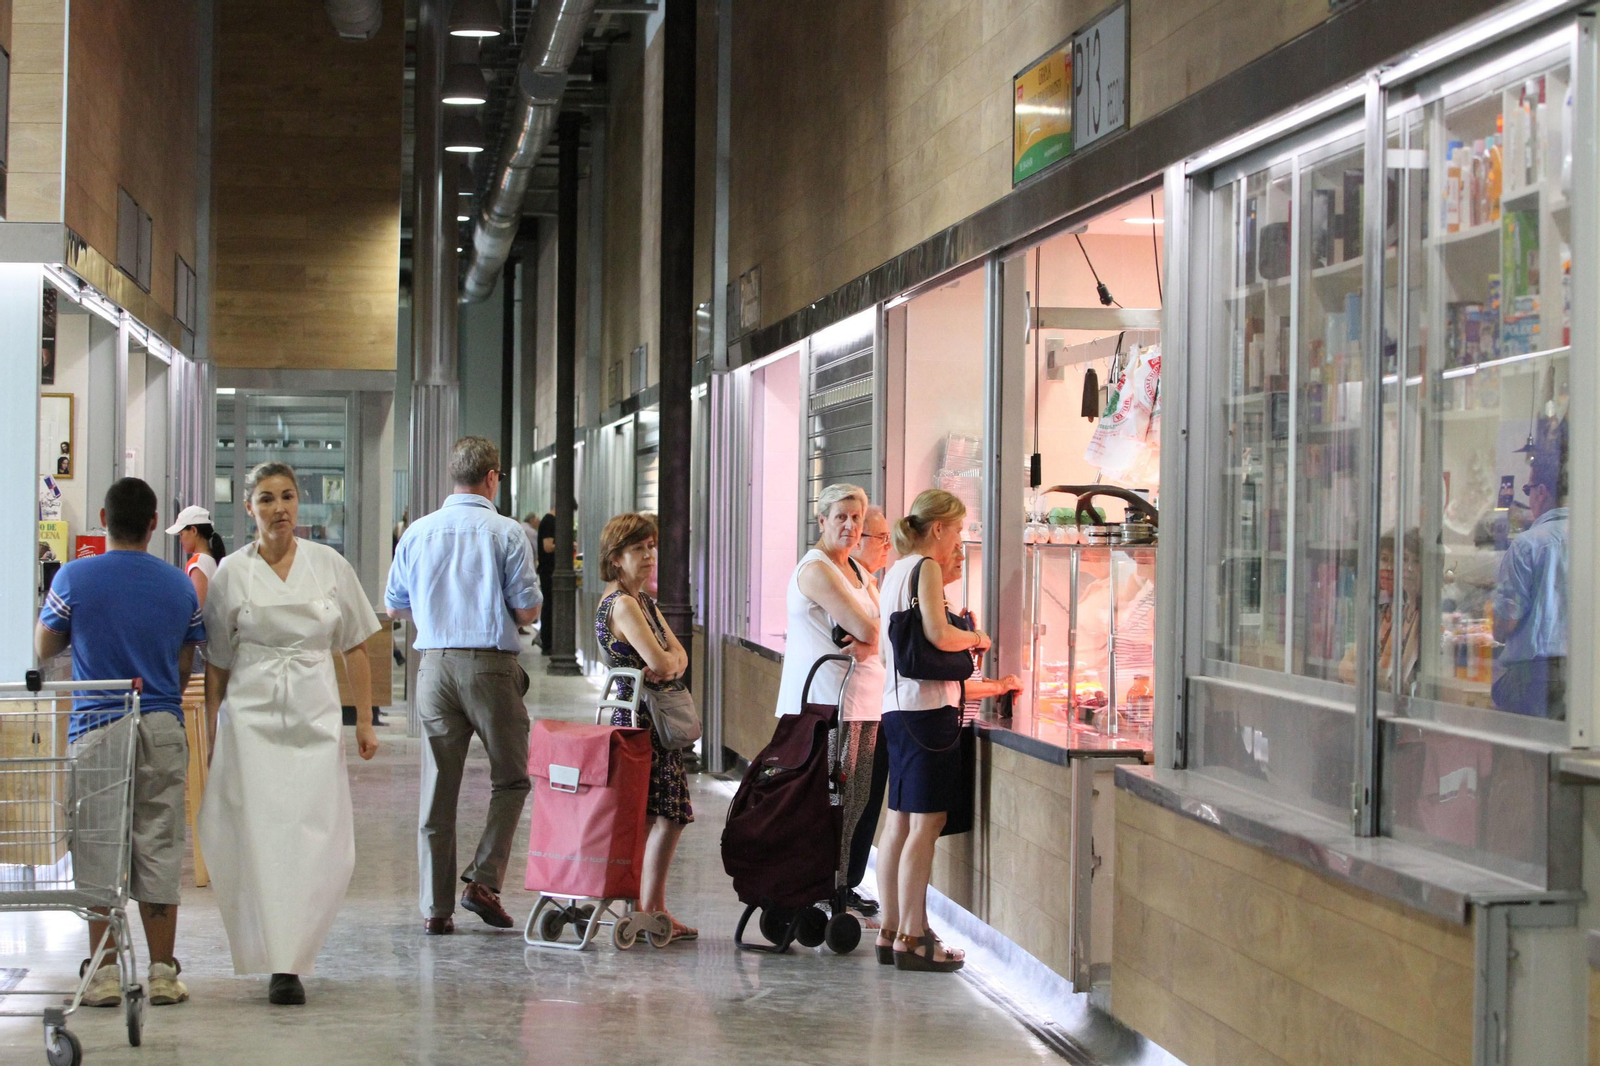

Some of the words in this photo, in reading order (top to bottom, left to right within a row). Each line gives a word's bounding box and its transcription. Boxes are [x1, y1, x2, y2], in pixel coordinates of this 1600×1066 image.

[1075, 28, 1101, 143] P13
[47, 523, 57, 531] DE
[39, 531, 60, 540] CENA
